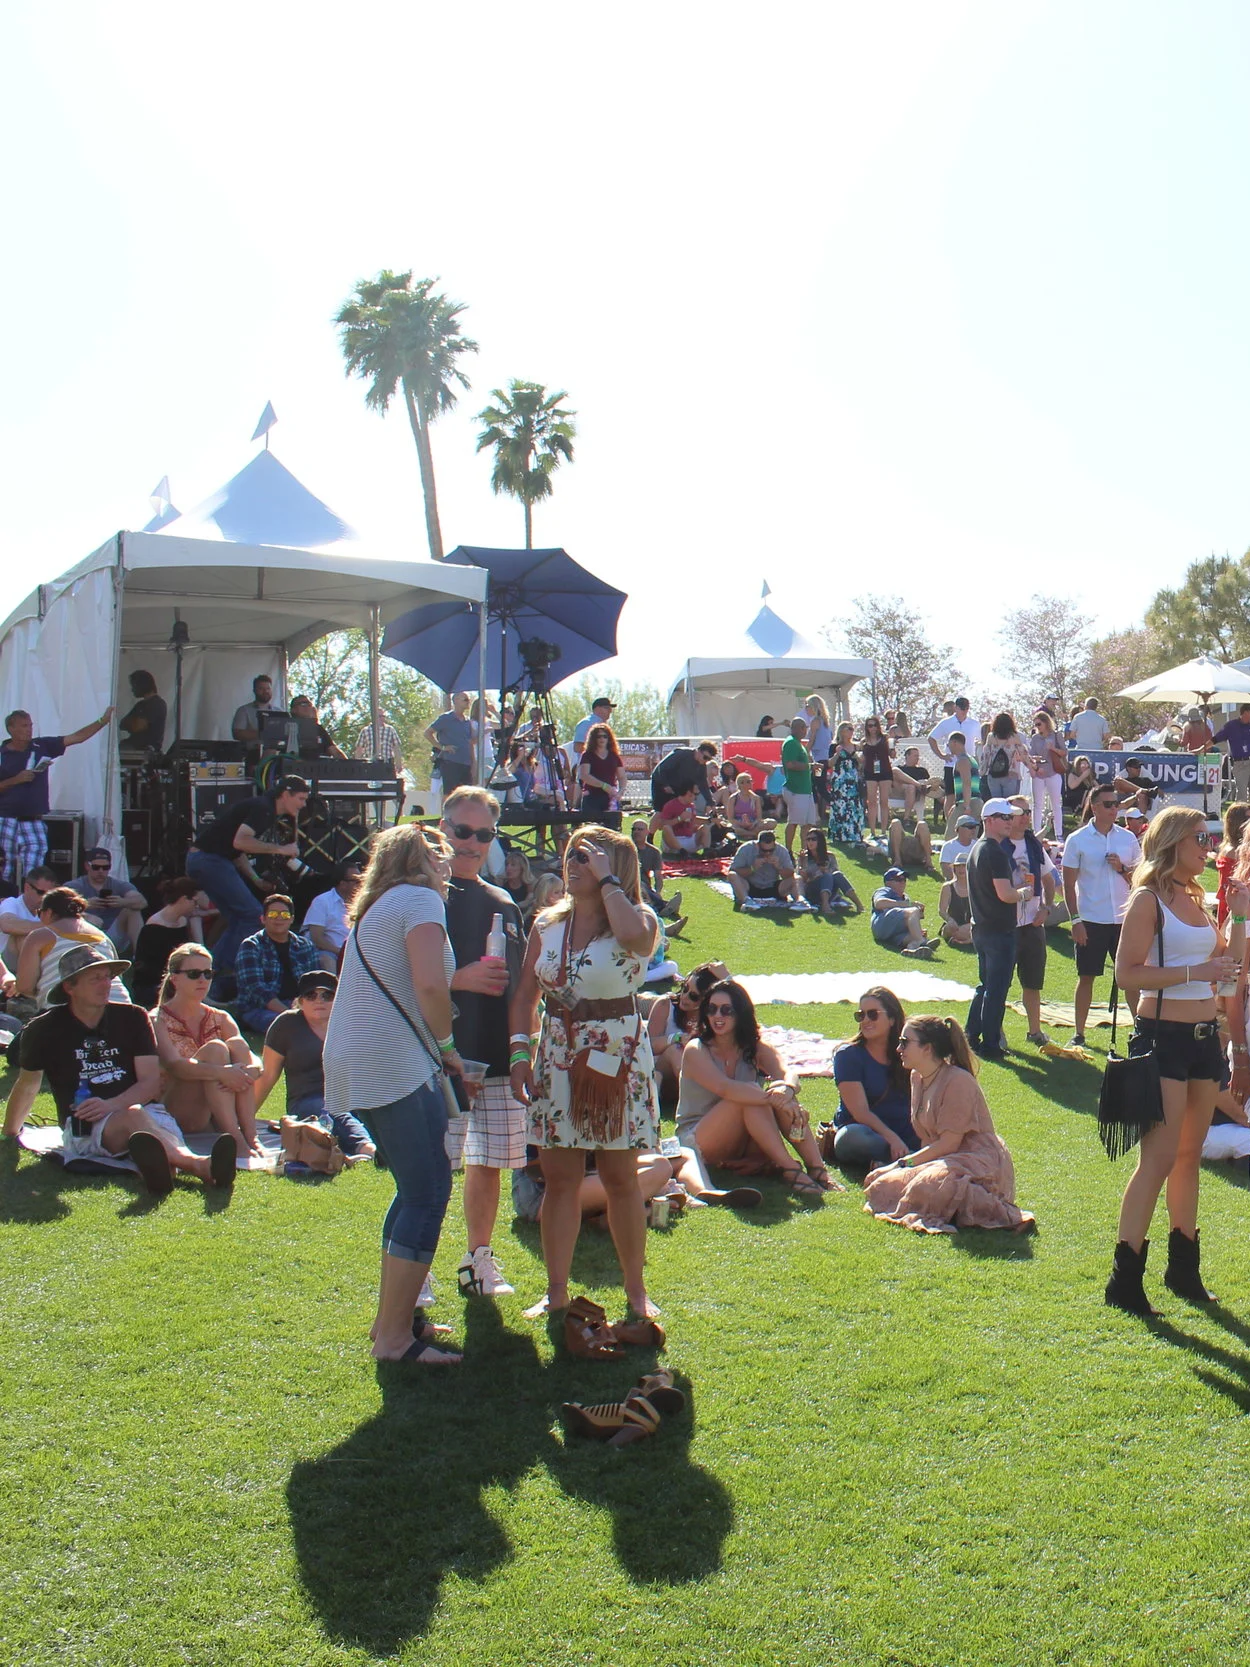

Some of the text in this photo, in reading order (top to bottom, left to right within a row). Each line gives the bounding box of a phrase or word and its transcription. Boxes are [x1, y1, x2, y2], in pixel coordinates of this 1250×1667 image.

[620, 743, 647, 752] ERICA'S
[1094, 762, 1109, 780] P
[1114, 763, 1197, 782] LUNG
[1208, 768, 1220, 783] 21
[83, 1039, 107, 1049] Te
[75, 1048, 120, 1060] Bren
